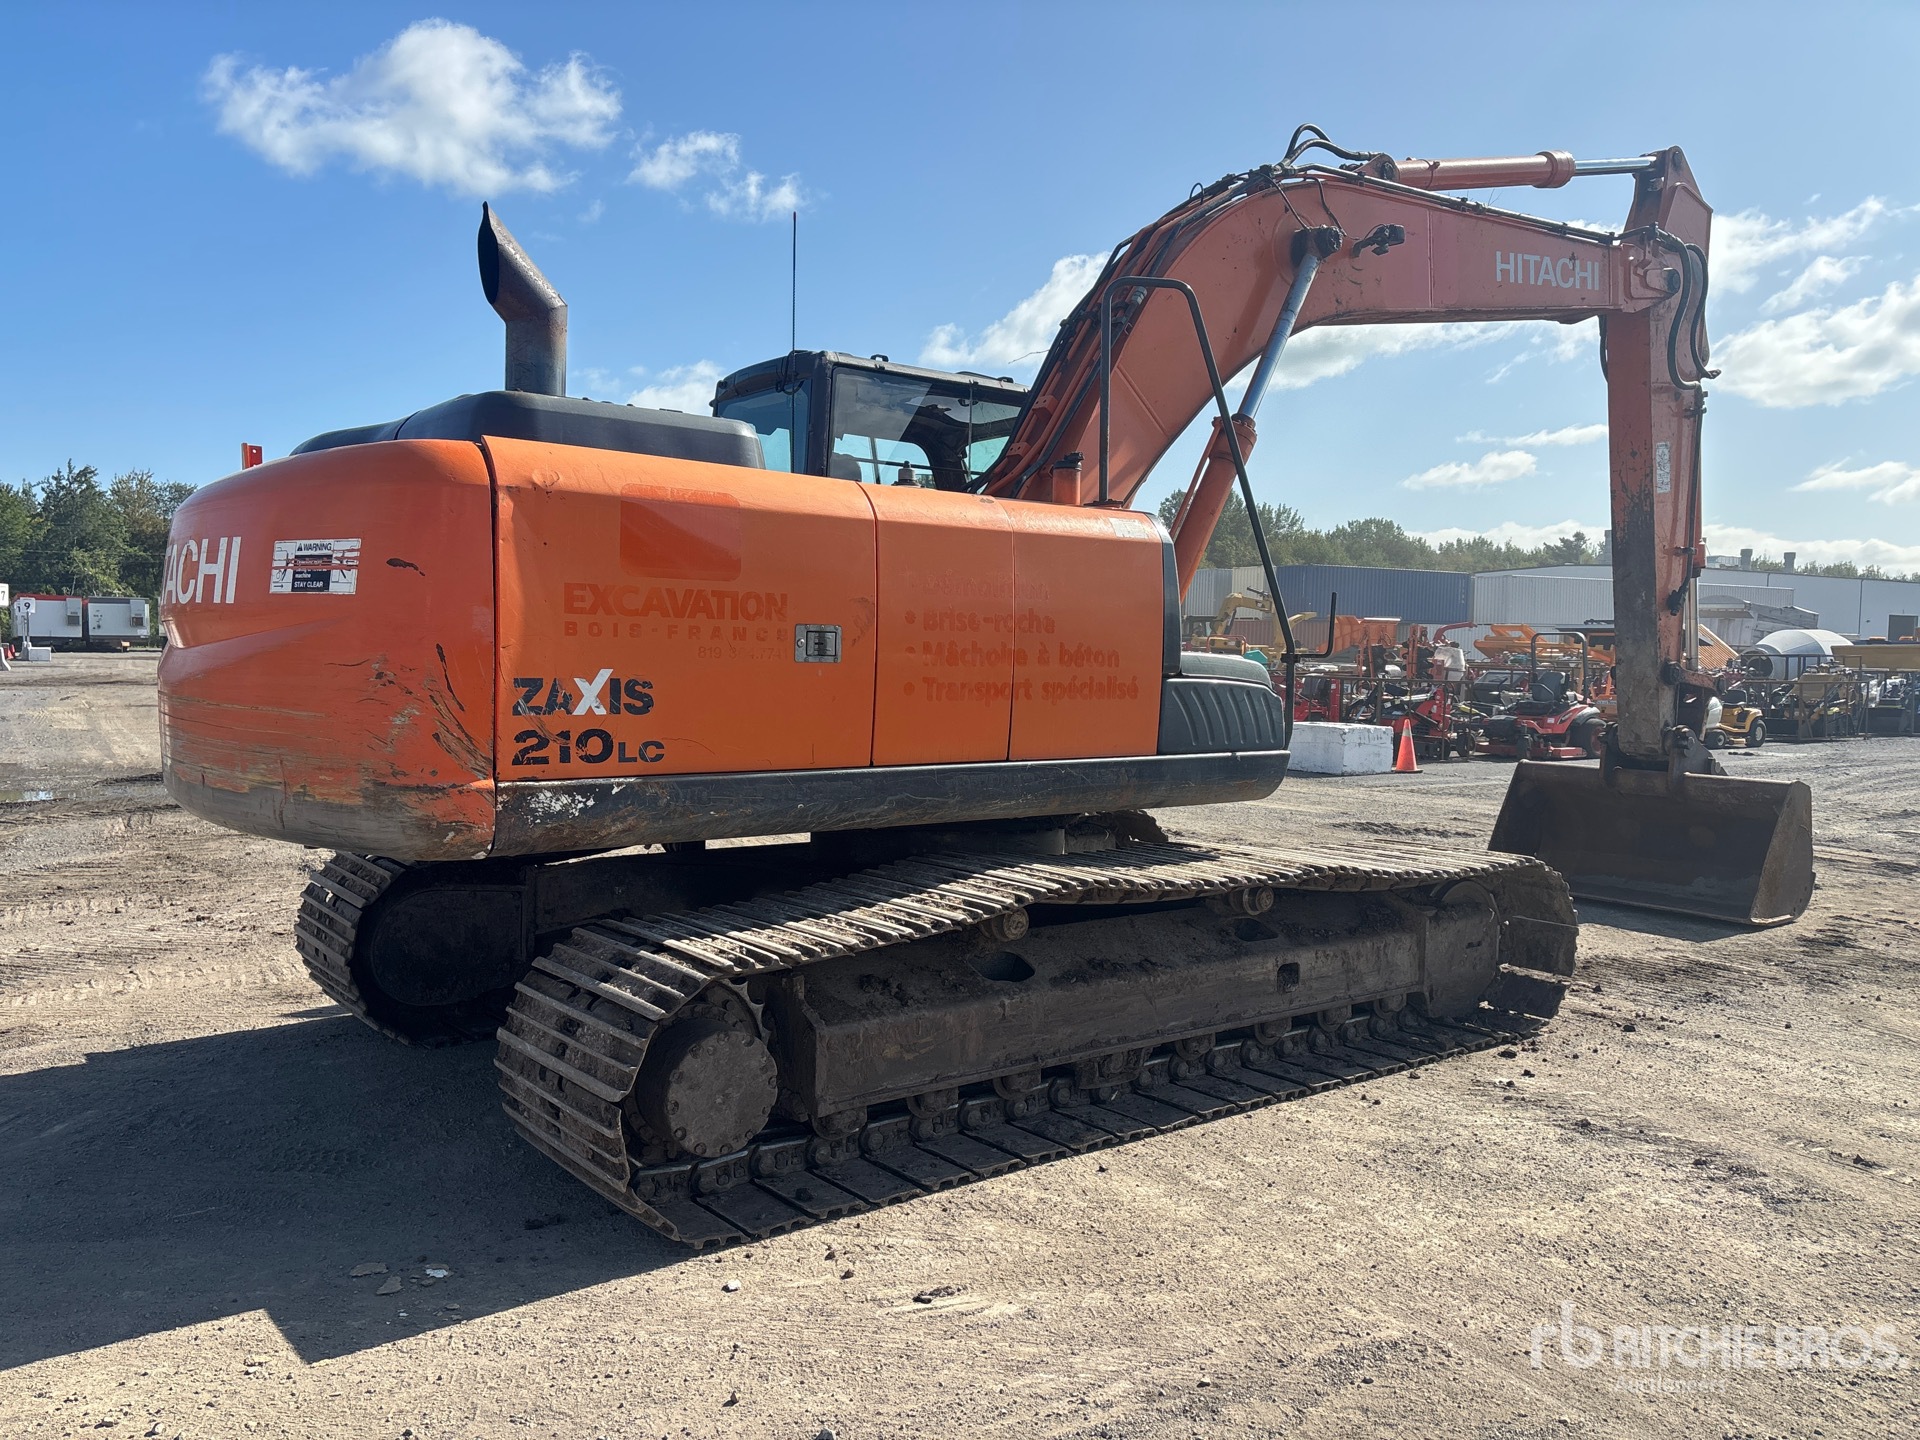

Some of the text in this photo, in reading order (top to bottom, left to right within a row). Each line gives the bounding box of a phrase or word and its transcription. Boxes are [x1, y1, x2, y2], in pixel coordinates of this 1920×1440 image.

[1495, 250, 1599, 290] HITACHI
[303, 542, 332, 552] WARNING
[24, 601, 31, 611] 9
[563, 582, 788, 621] EXCAVATION
[698, 646, 721, 659] 819
[1060, 641, 1120, 667] béton
[512, 668, 654, 716] ZAXIS
[922, 675, 1139, 706] Transport spécialisé
